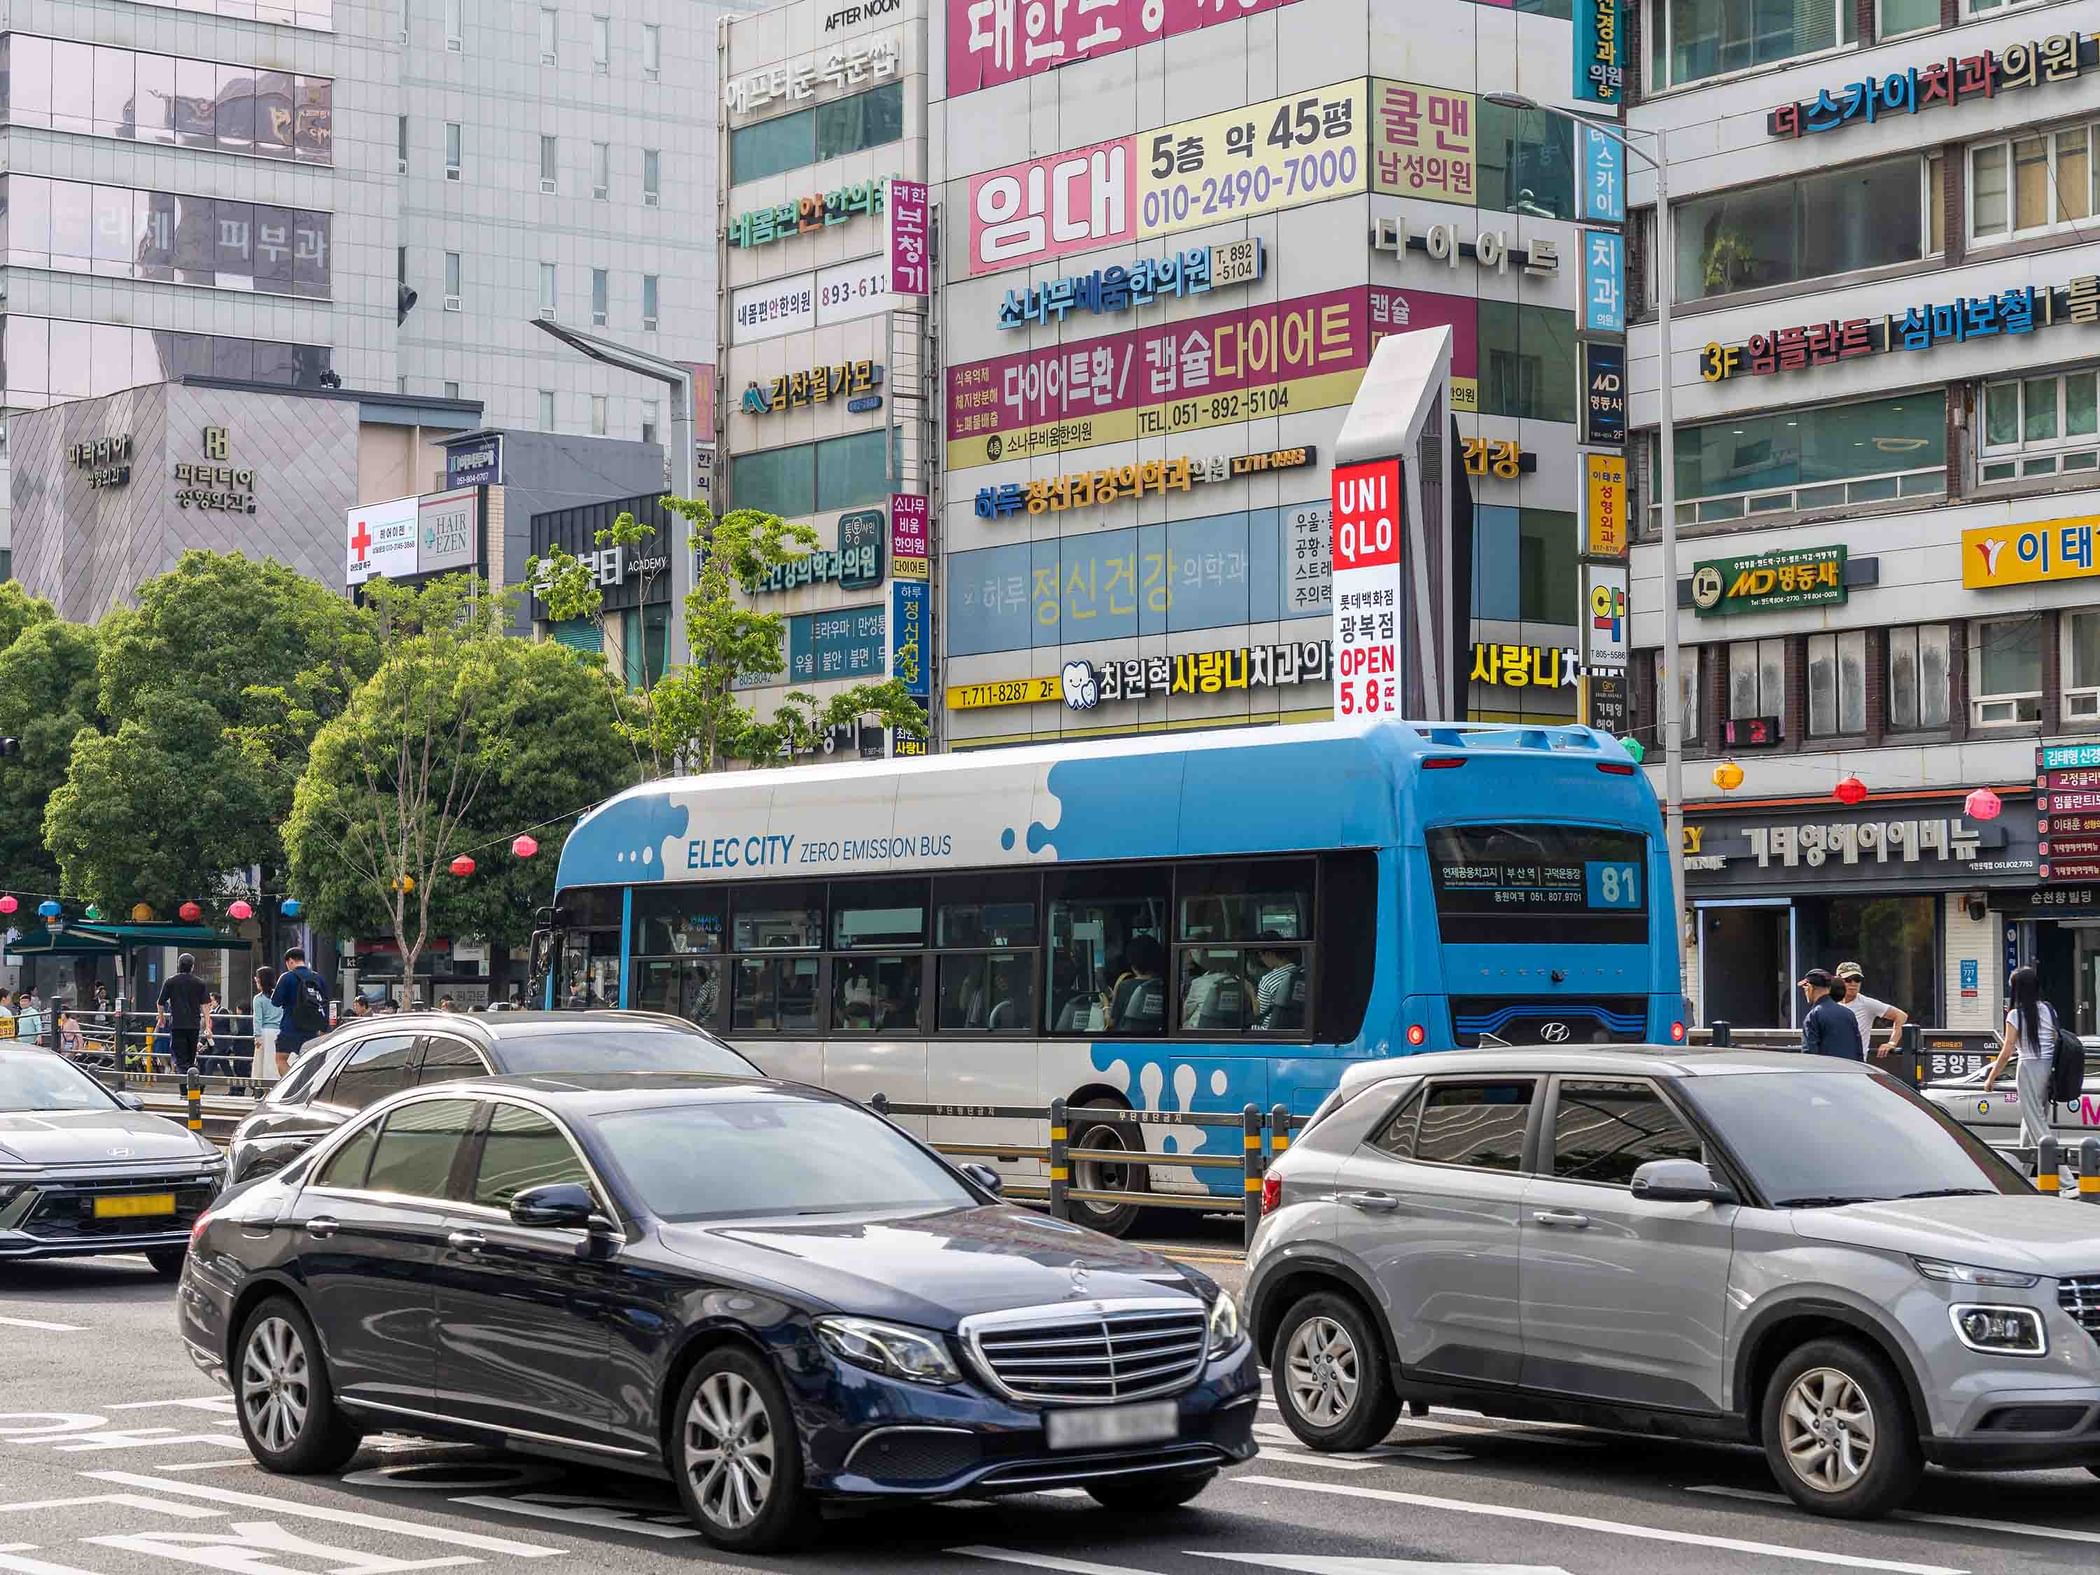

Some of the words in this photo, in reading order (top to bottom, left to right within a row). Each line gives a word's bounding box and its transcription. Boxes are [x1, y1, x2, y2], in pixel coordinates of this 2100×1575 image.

[824, 6, 861, 32] AFTER
[863, 0, 900, 21] NOON
[727, 61, 818, 114] 애프터눈
[824, 33, 900, 89] 속눈썹
[1590, 64, 1622, 87] 의원
[1598, 84, 1614, 97] 5F
[1380, 87, 1470, 154] 쿨맨
[1150, 133, 1205, 180] 5층
[1226, 122, 1255, 160] 약
[1266, 97, 1353, 150] 45평
[1143, 145, 1357, 229] 010-2490-7000
[1378, 150, 1472, 195] 남성의원
[893, 185, 926, 204] 대한
[975, 143, 1126, 265] 임대
[218, 219, 328, 269] 피부과
[897, 206, 924, 292] 보청기
[1216, 249, 1226, 265] T.
[1230, 243, 1253, 263] 892
[1374, 215, 1560, 279] 다이어트
[1216, 260, 1253, 281] -5104
[1592, 238, 1620, 313] 치과
[737, 289, 812, 328] 내몸편안한의원
[1370, 292, 1410, 325] 캡슐
[1703, 341, 1741, 383] 3F
[1748, 317, 1871, 377] 임플란트
[1899, 285, 2036, 352] 심미보철
[1590, 395, 1623, 412] 명동사
[1007, 421, 1092, 454] 소나무비움한의원
[1462, 436, 1521, 480] 건강
[894, 498, 925, 514] 소나무
[1339, 475, 1387, 515] UNI
[436, 512, 466, 535] HAIR
[899, 518, 919, 534] 비움
[1601, 485, 1615, 544] 성형외과
[436, 531, 466, 554] EZEN
[894, 536, 925, 555] 한의원
[1340, 517, 1392, 562] QLO
[628, 556, 667, 573] ACADEMY
[894, 560, 927, 574] 다이어트
[1727, 568, 1777, 598] MD
[1778, 560, 1839, 592] 명동사
[901, 586, 922, 598] 하루
[1032, 548, 1178, 626] 정신건강
[1183, 550, 1248, 589] 의학과
[1340, 588, 1394, 611] 롯데백화점
[811, 618, 850, 640] 트라우마
[1340, 611, 1394, 644] 광복점
[795, 653, 813, 674] 우울
[823, 648, 842, 672] 불안
[850, 647, 869, 668] 불면
[1340, 644, 1394, 677] OPEN
[961, 682, 1028, 707] T.711-8287
[1040, 681, 1054, 698] 2F
[1340, 678, 1380, 715] 5.8
[1384, 677, 1395, 712] FRI
[896, 741, 926, 755] 사랑니
[687, 839, 740, 869] ELEC
[743, 834, 796, 867] CITY
[800, 842, 839, 863] ZERO
[843, 837, 918, 861] EMISSION
[920, 834, 952, 858] BUS
[1442, 866, 1498, 879] 연제공용차고지
[1544, 867, 1581, 880] 구덕운동장
[1601, 866, 1636, 903] 81
[1494, 891, 1525, 902] 동원여객
[2069, 889, 2092, 904] 빌딩
[346, 958, 357, 968] kt
